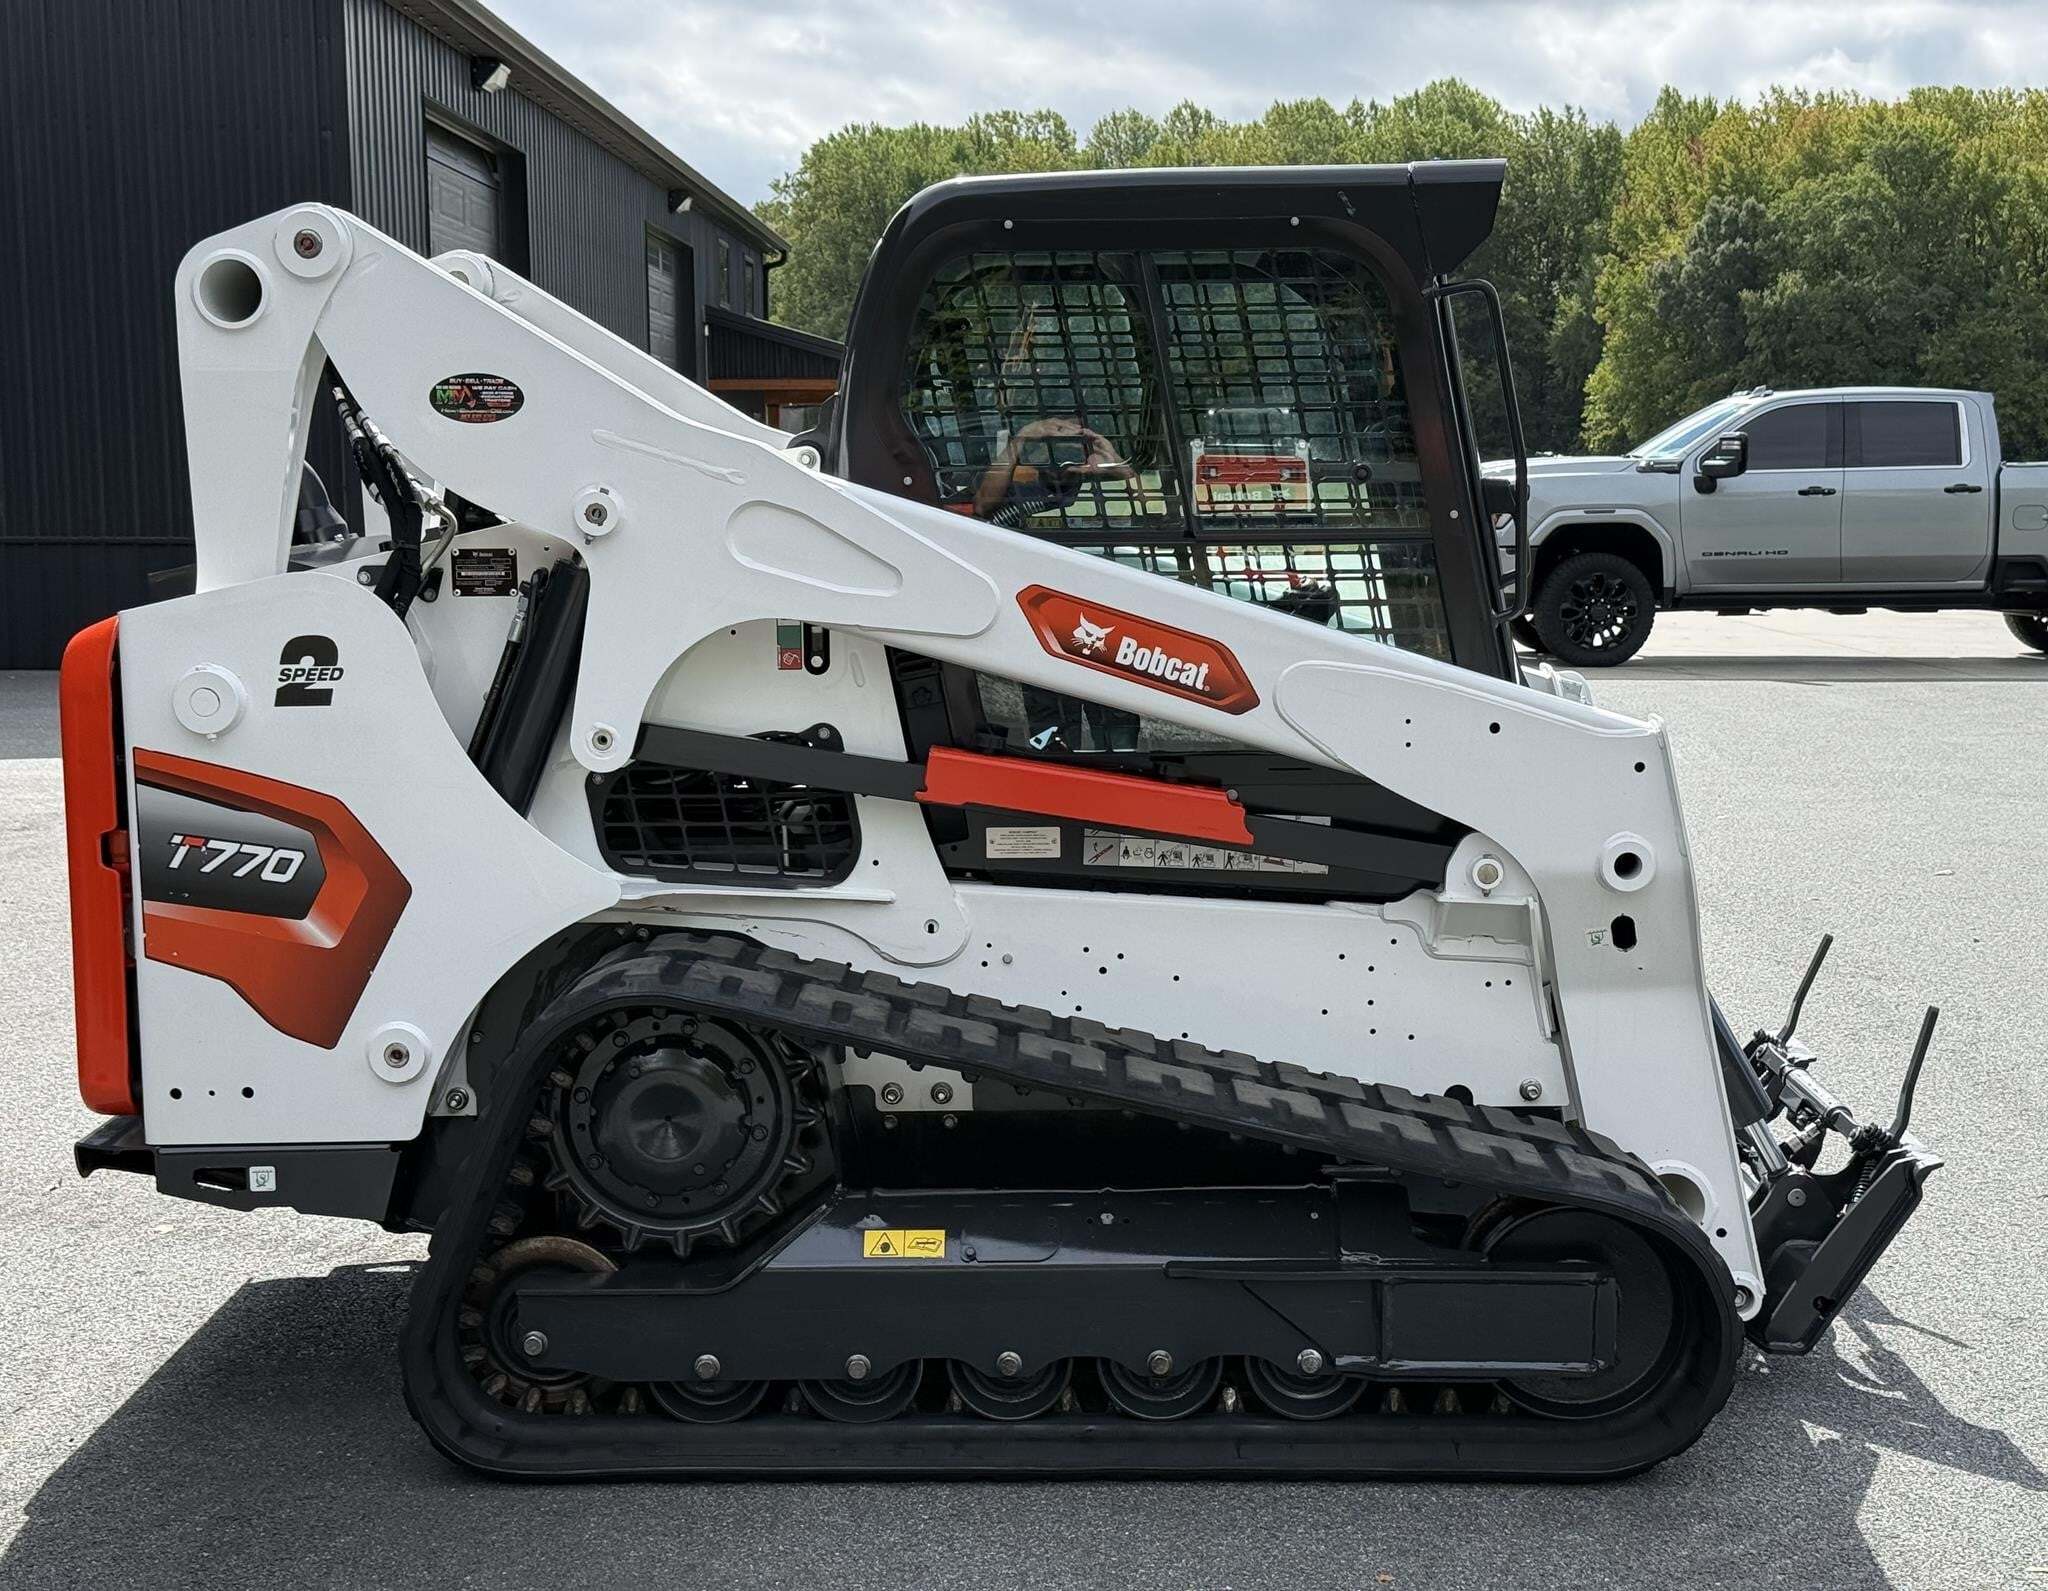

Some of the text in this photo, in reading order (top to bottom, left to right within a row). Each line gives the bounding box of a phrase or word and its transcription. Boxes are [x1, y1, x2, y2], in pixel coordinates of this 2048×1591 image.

[274, 635, 344, 707] 2 SPEED
[168, 832, 306, 883] T770
